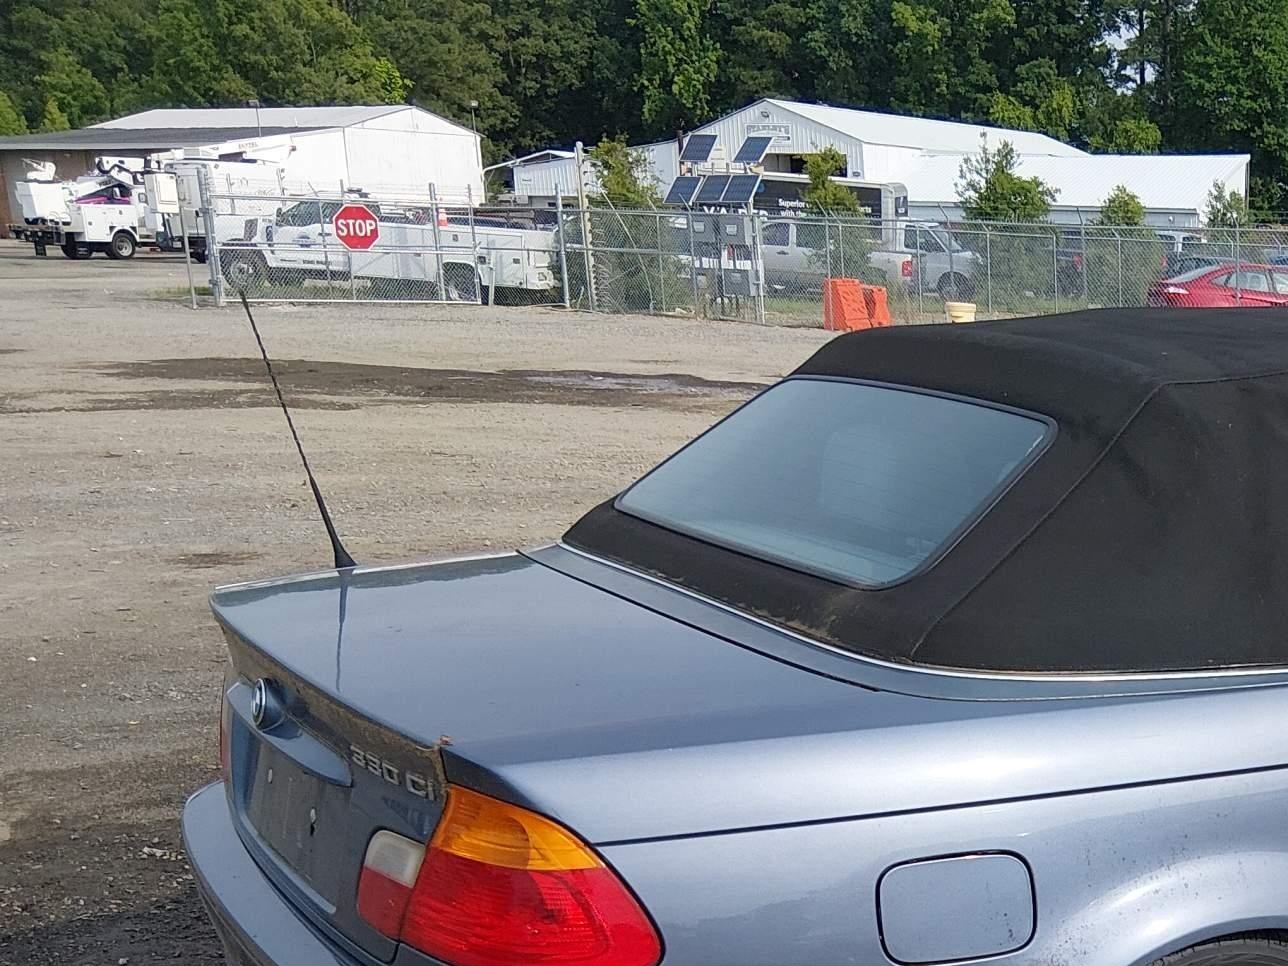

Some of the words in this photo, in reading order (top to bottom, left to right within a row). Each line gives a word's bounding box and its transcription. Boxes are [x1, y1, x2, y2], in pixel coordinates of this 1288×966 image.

[778, 198, 805, 209] Superior
[337, 218, 376, 237] STOP
[351, 744, 399, 785] 330
